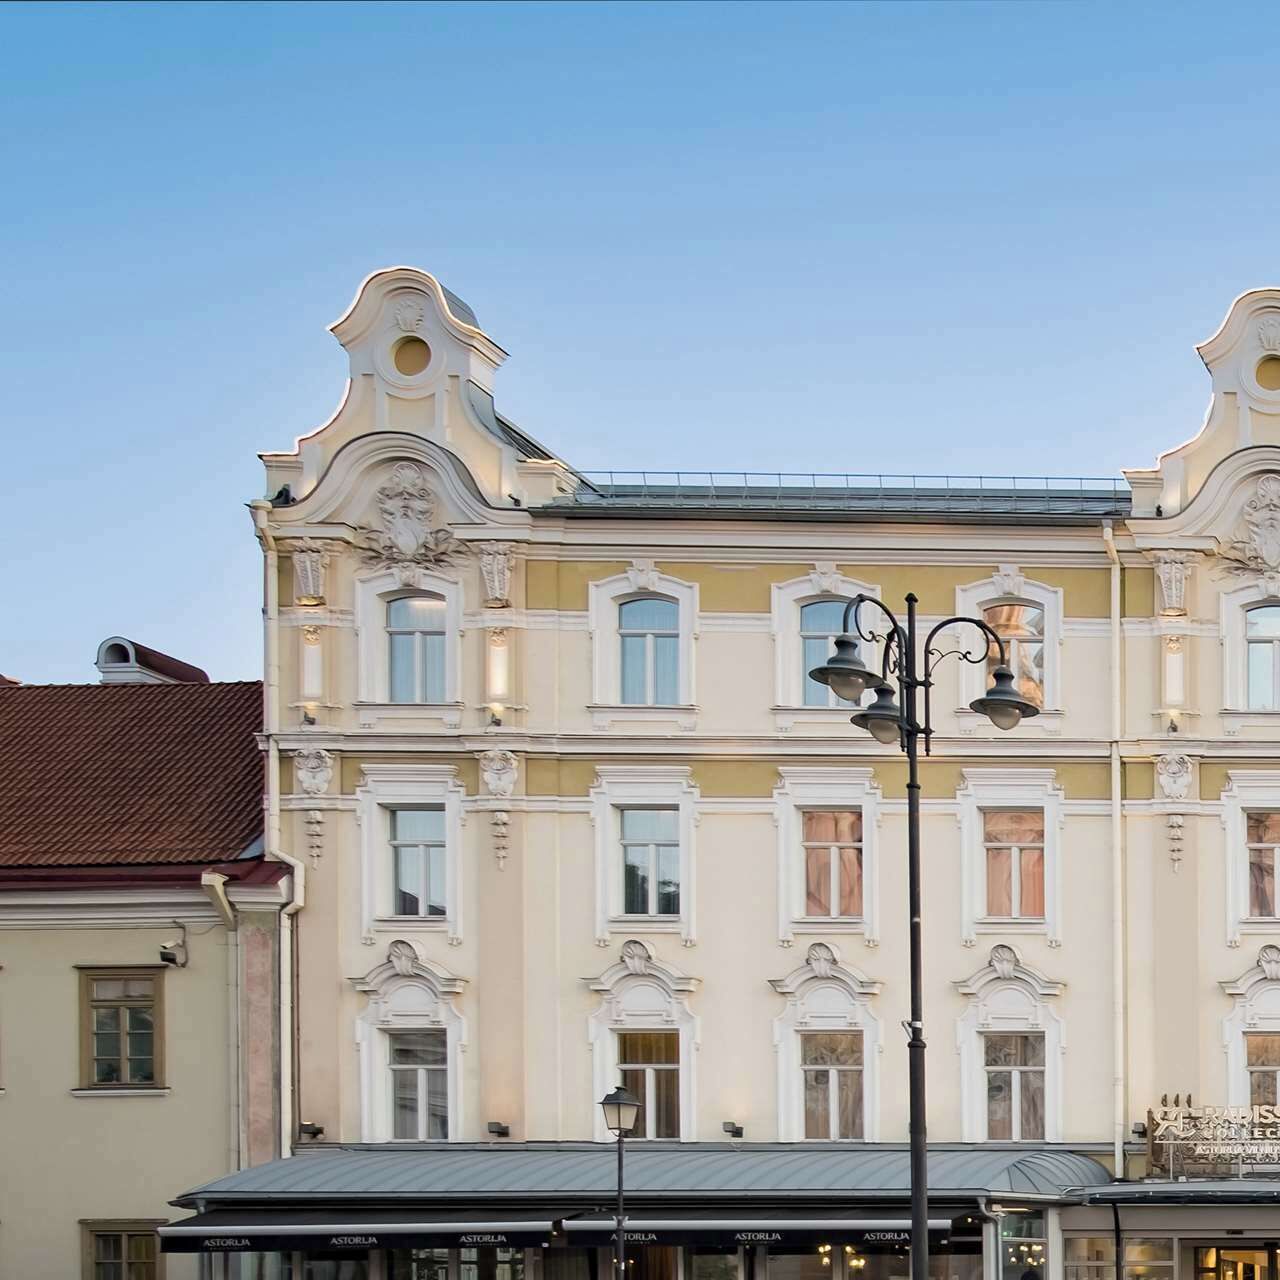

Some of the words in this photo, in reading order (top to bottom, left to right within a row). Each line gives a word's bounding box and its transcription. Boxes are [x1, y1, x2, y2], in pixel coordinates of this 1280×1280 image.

[330, 1236, 378, 1245] ASTORIJA
[459, 1234, 507, 1243] ASTORIJA
[610, 1232, 657, 1241] ATORIJA
[734, 1232, 782, 1241] ASTORIJA
[863, 1232, 910, 1241] ASTORIJA
[203, 1238, 250, 1247] ASTORIJA
